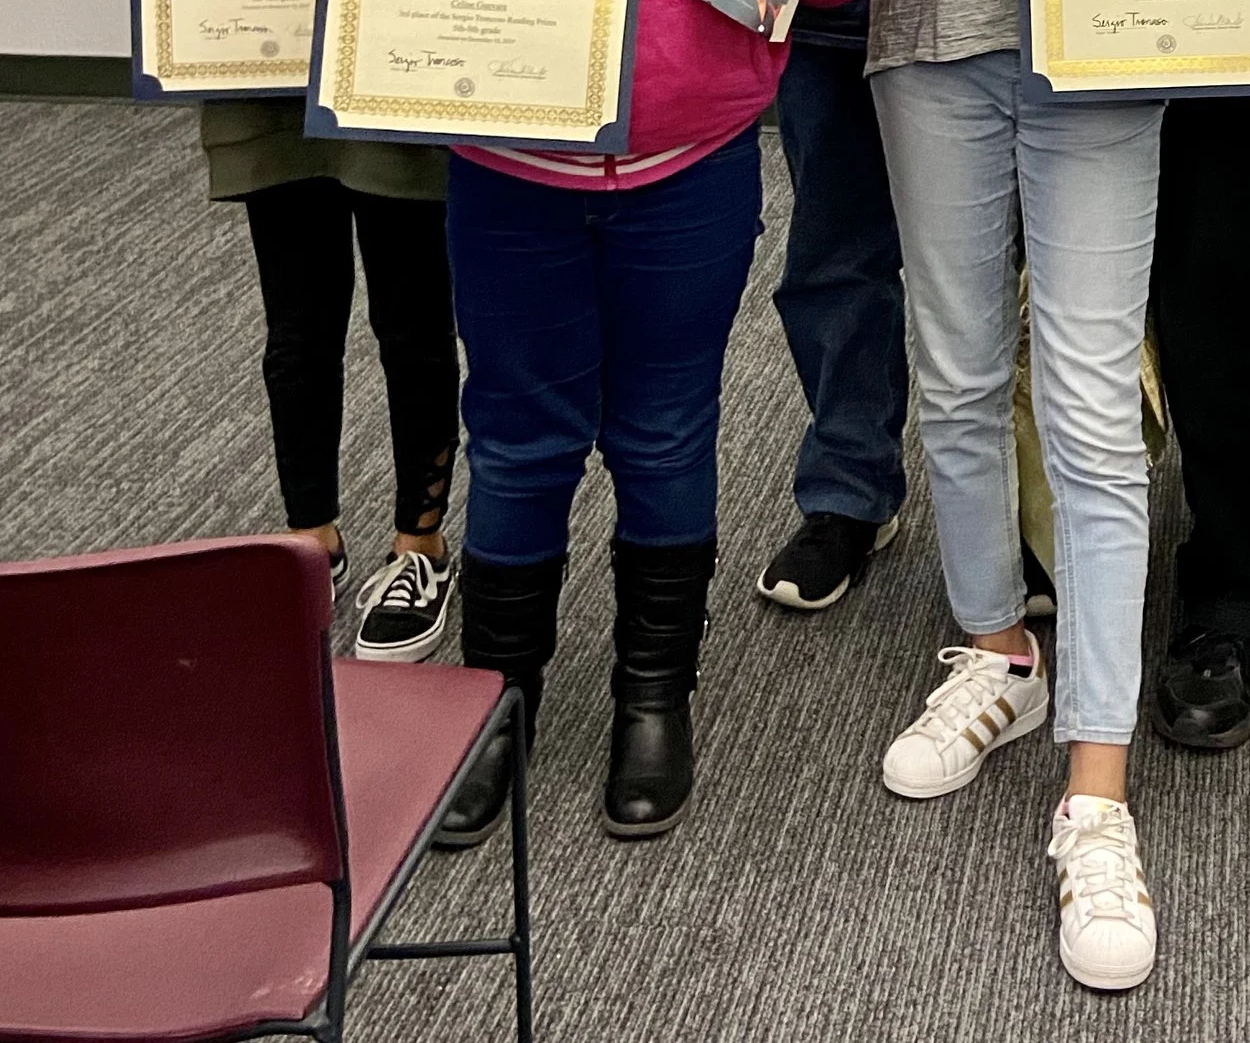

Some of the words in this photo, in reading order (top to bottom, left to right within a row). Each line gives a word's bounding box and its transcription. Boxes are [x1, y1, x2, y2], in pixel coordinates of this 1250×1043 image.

[411, 11, 429, 21] place
[452, 13, 473, 23] Sergio
[481, 25, 501, 35] grade
